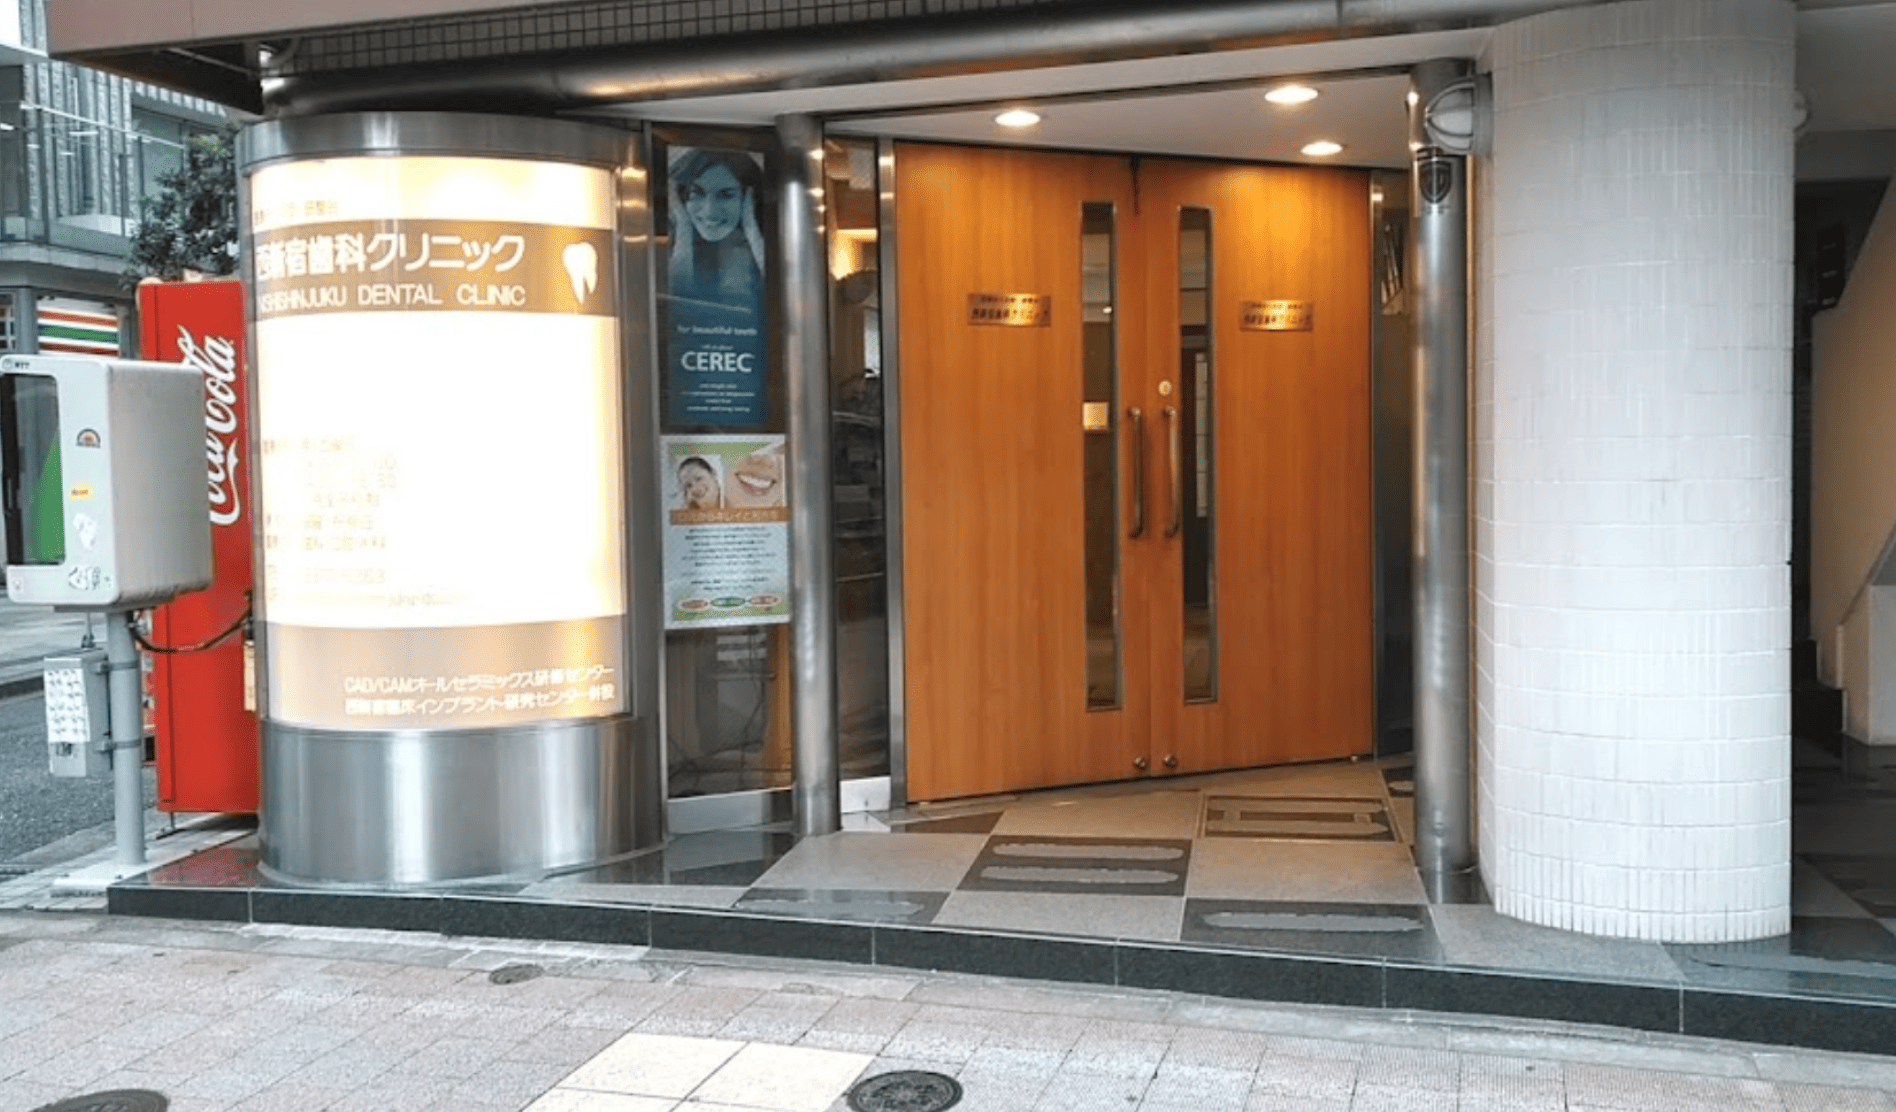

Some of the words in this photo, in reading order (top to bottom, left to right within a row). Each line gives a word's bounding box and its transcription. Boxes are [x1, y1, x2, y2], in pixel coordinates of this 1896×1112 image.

[357, 283, 443, 306] DENTAL
[456, 284, 526, 307] CLINIC
[692, 325, 732, 335] beautiful
[680, 351, 755, 373] CEREC
[177, 323, 241, 526] CocaCola
